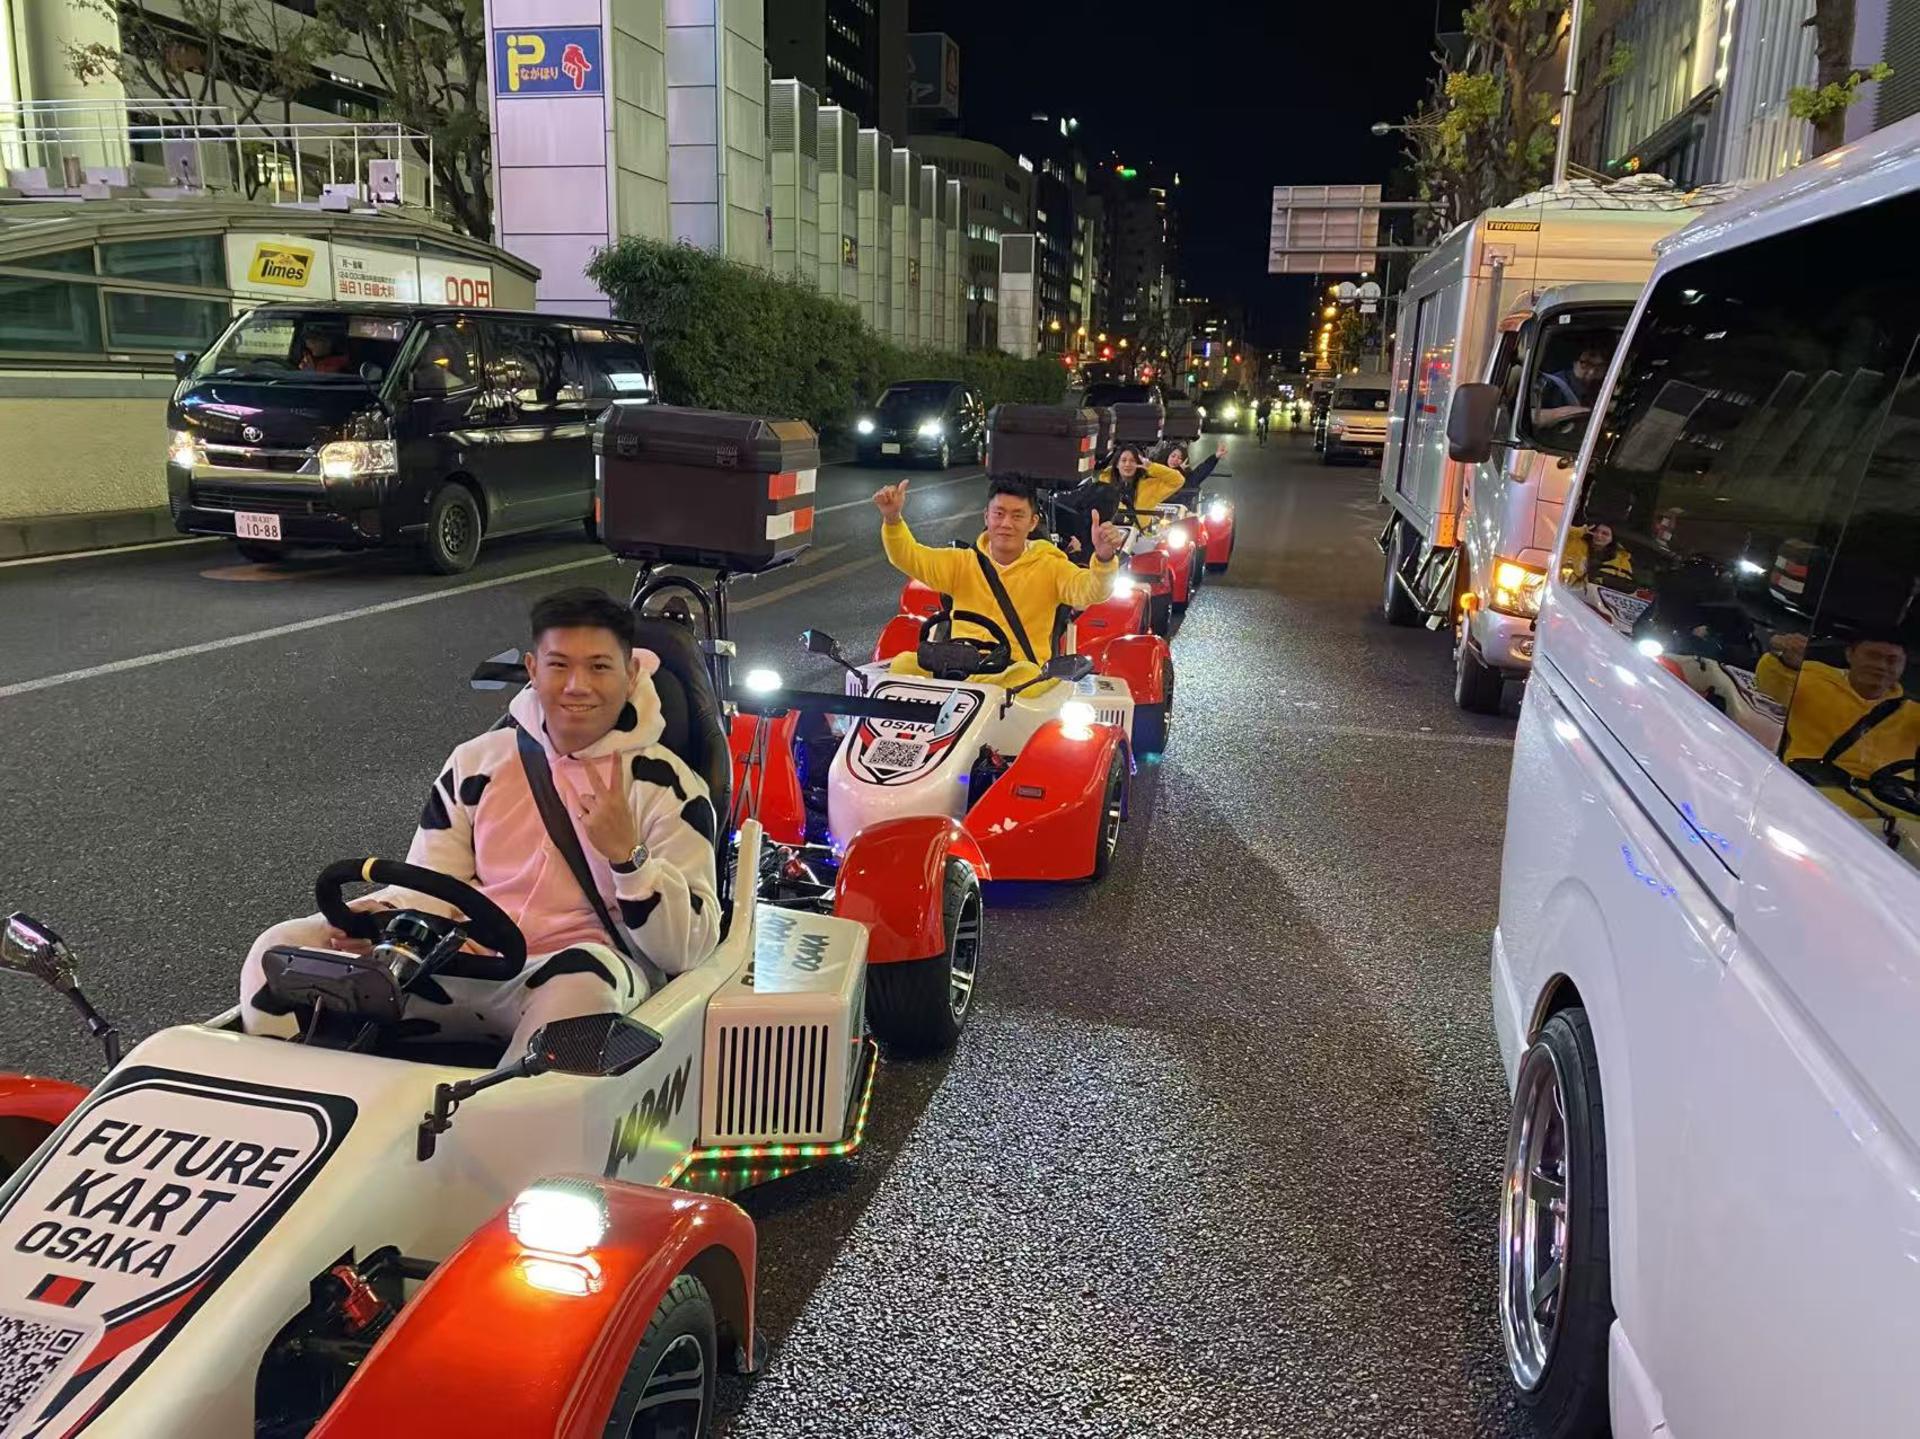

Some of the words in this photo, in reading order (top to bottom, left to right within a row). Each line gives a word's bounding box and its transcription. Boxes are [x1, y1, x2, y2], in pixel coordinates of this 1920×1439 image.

[520, 66, 559, 80] ながほり
[247, 523, 278, 537] 10-88
[792, 933, 830, 972] OSAKA
[67, 1119, 300, 1189] FUTURE
[44, 1168, 236, 1237] KART
[14, 1220, 177, 1279] OSAKA
